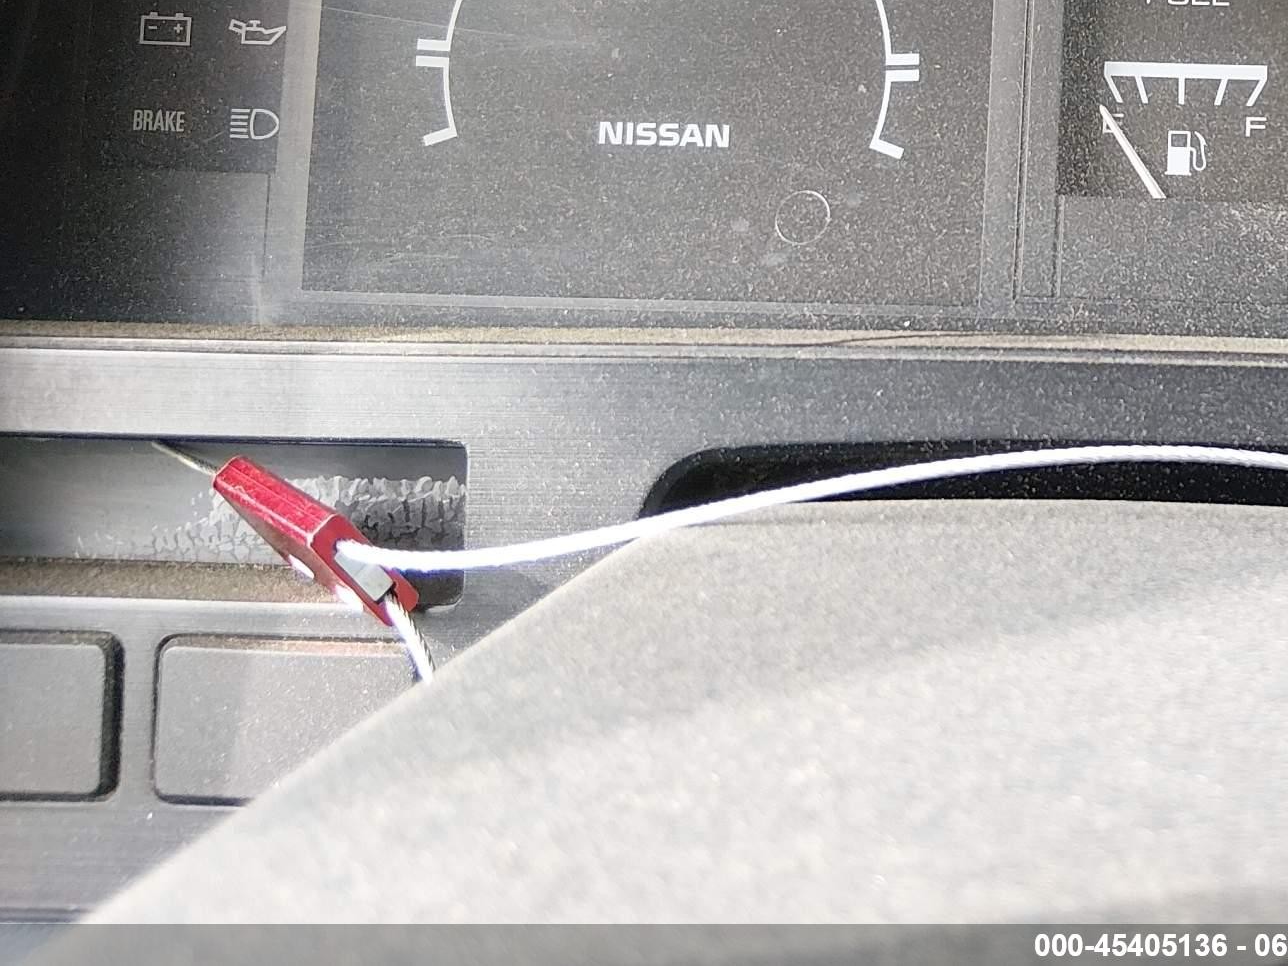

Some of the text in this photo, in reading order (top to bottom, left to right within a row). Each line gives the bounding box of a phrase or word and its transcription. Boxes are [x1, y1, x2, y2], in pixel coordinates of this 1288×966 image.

[132, 109, 185, 132] BRAKE
[1245, 116, 1267, 137] F
[598, 121, 730, 148] NISSAN
